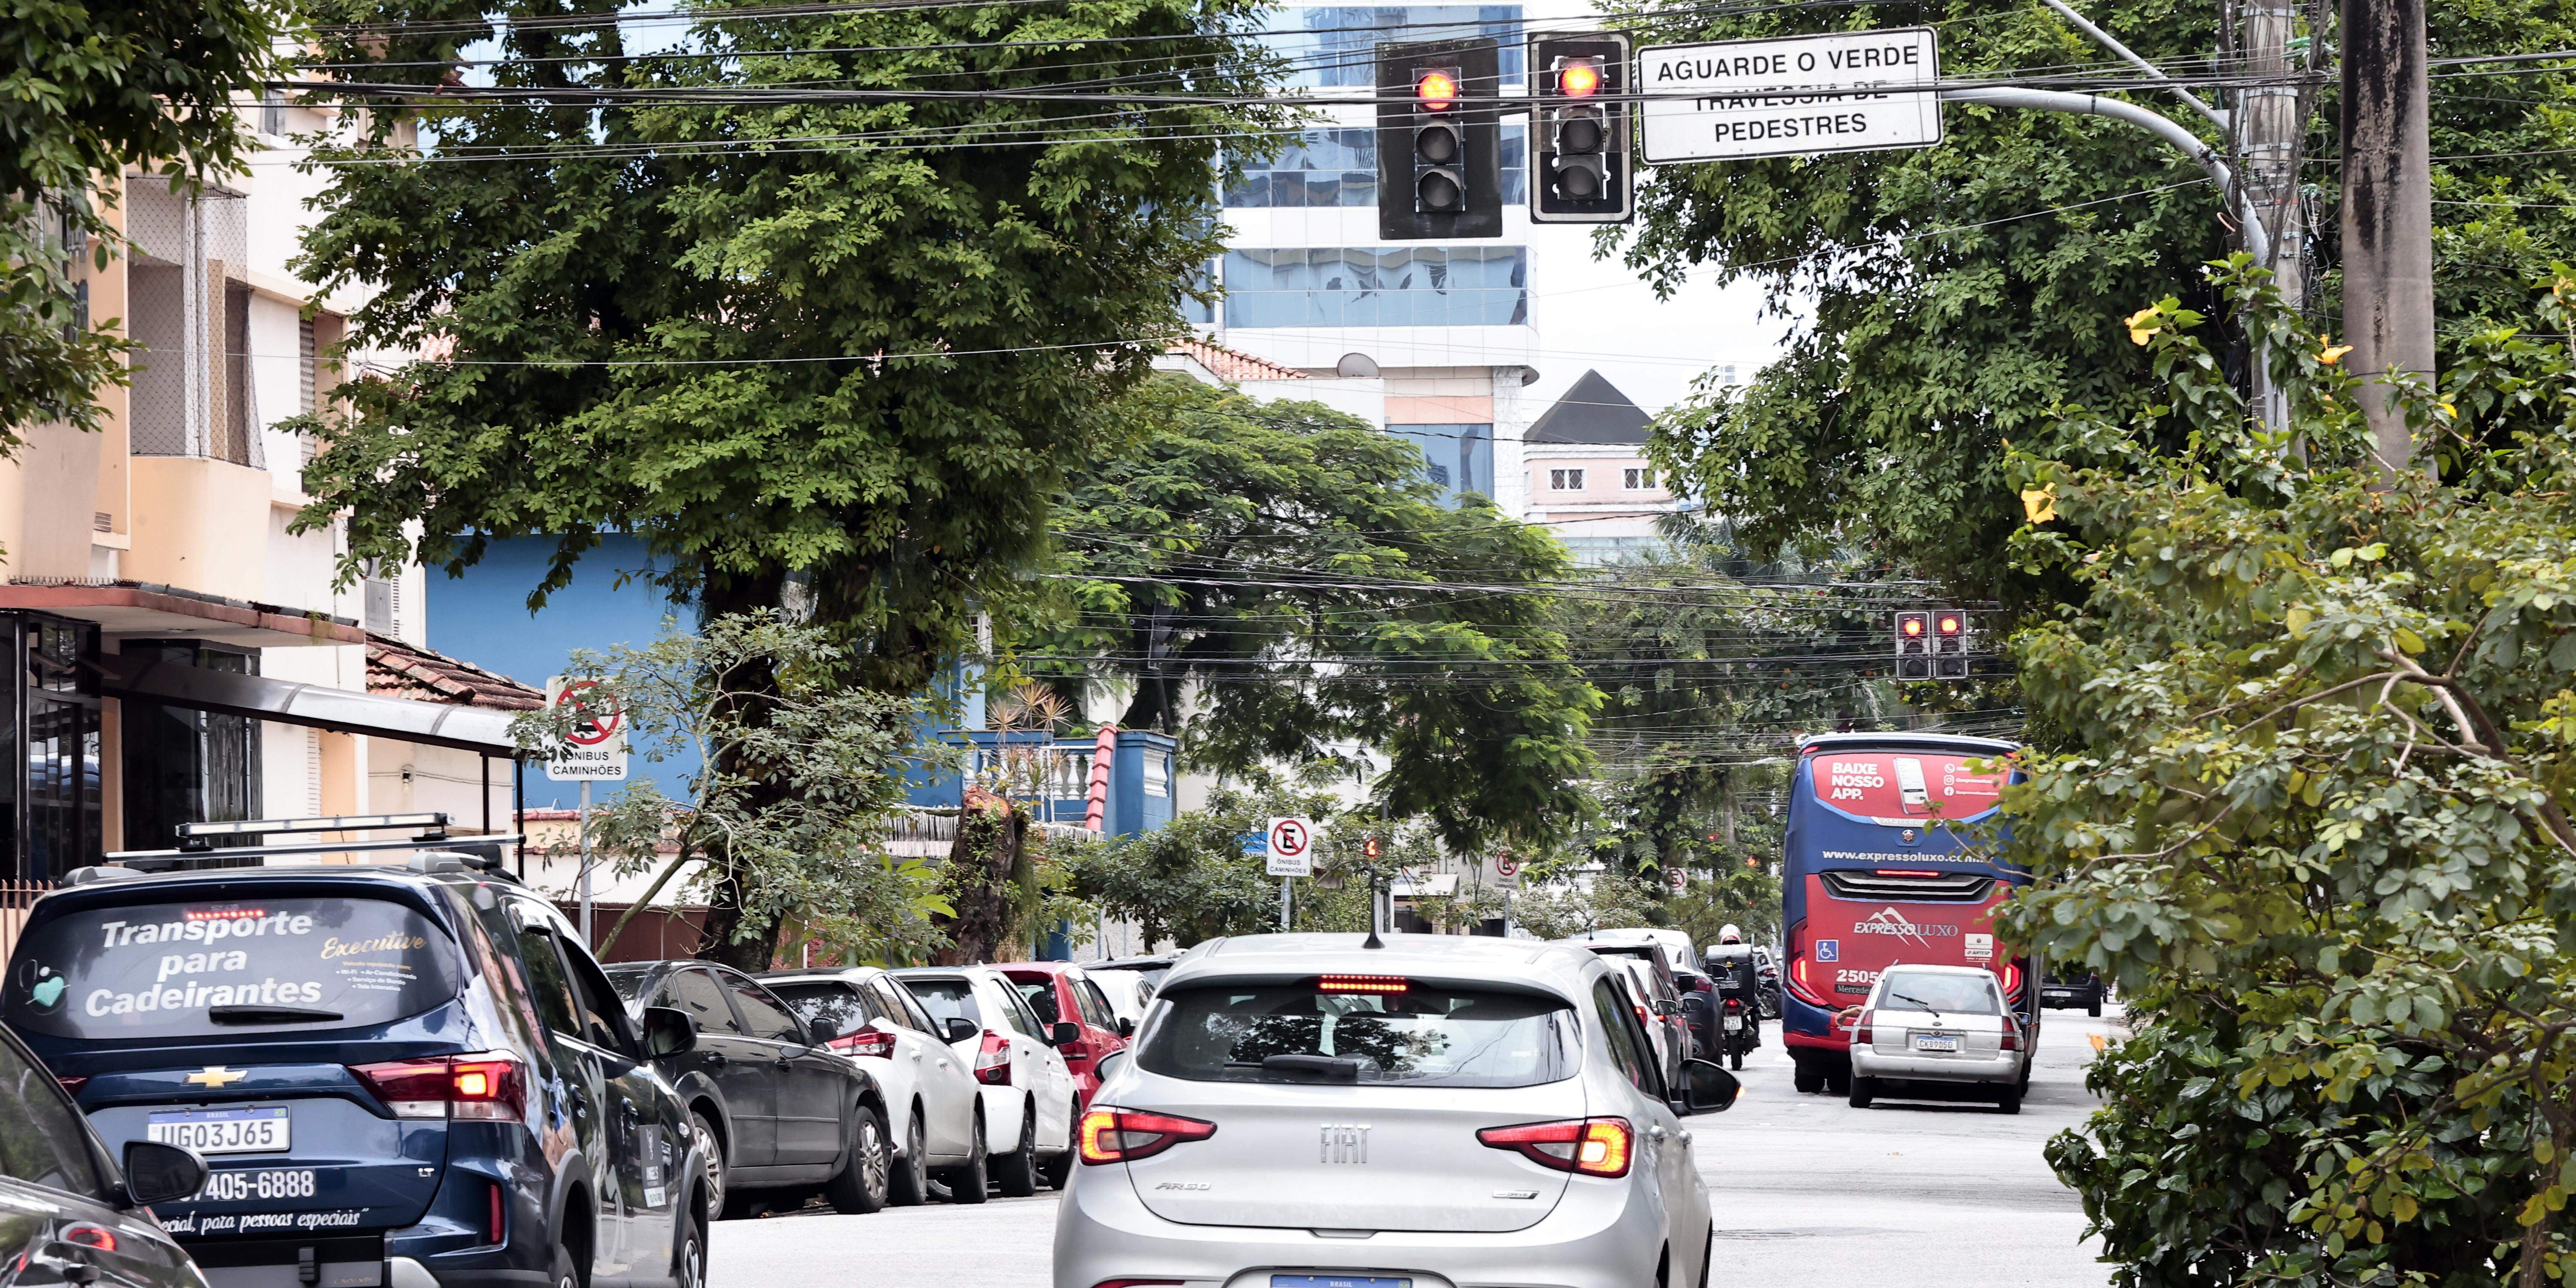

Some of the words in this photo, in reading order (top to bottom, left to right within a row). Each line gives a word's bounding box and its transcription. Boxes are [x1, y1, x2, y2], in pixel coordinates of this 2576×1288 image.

[1658, 54, 1787, 81] AGUARDE
[1798, 52, 1816, 72] O
[1828, 46, 1918, 69] VERDE
[1854, 80, 1888, 100] DE
[1716, 113, 1867, 142] PEDESTRES
[553, 764, 621, 775] CAMINHÕES
[1832, 762, 1878, 775] BAIXE
[1830, 787, 1864, 800] APP.
[1831, 775, 1885, 788] NOSSO
[101, 910, 313, 948] Transporte
[320, 930, 427, 959] Executive
[156, 950, 248, 982] para
[85, 977, 323, 1017] Cadeirantes
[1838, 985, 1870, 994] Mercede
[1321, 1124, 1372, 1163] FIAT
[201, 1215, 235, 1235] para
[239, 1213, 293, 1233] pessoas
